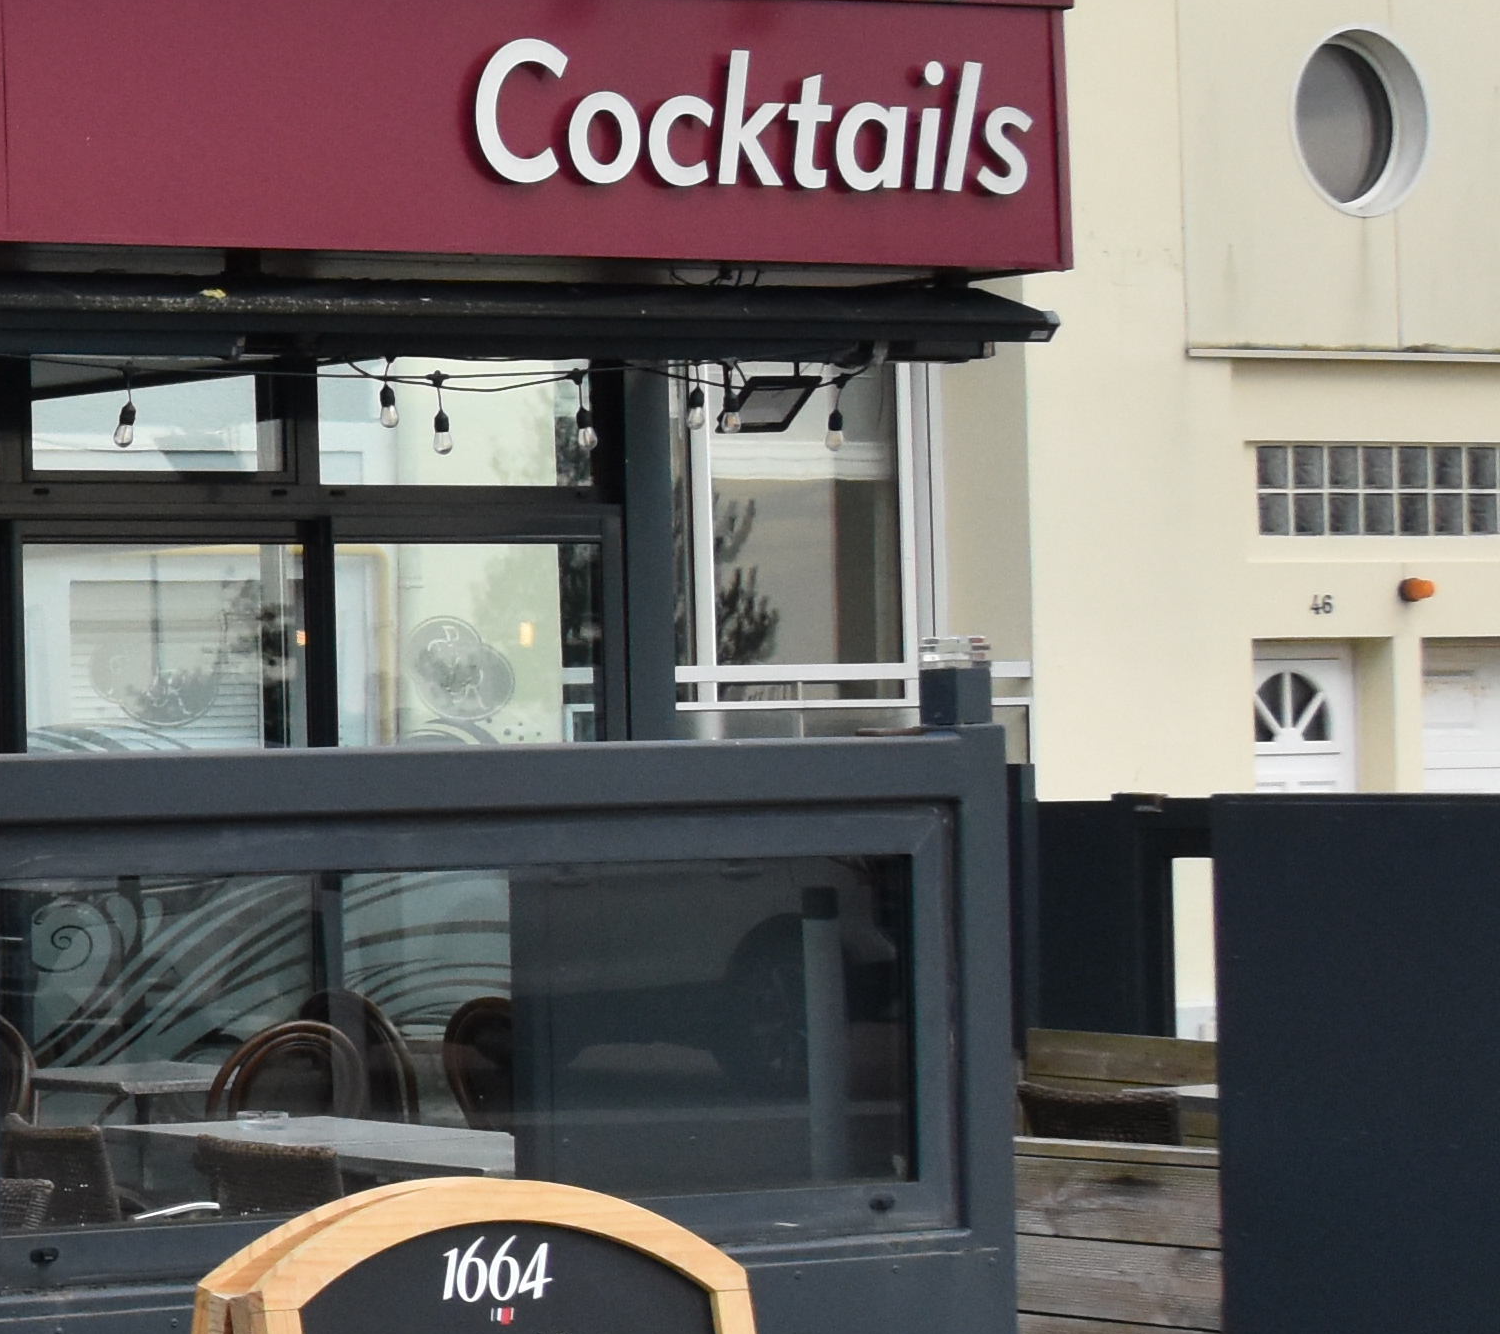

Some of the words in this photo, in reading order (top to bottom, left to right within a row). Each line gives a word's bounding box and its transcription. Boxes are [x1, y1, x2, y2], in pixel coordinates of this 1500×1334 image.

[475, 38, 1033, 195] Cocktails
[1310, 594, 1334, 614] 46
[442, 1235, 554, 1302] 1664
